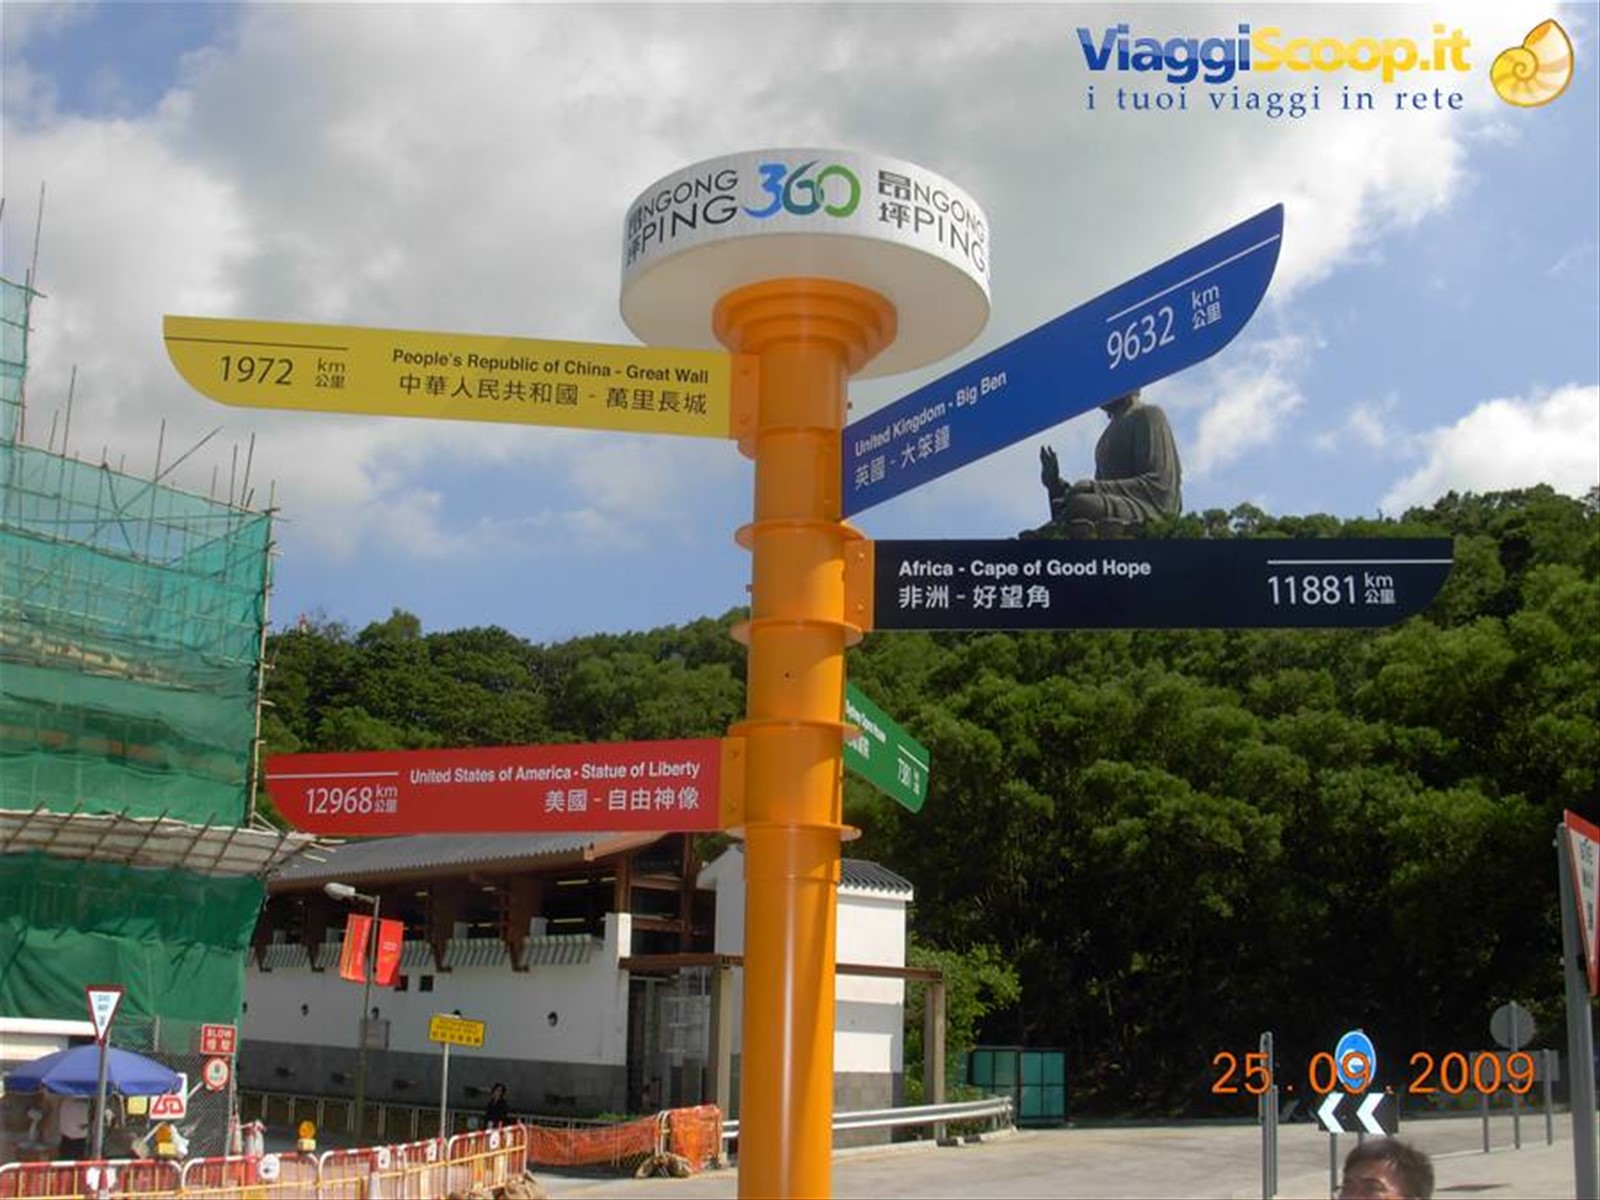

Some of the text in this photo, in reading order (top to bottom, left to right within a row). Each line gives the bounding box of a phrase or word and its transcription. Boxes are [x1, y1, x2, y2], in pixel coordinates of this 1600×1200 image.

[643, 169, 738, 220] NGONG
[741, 160, 861, 219] 360
[641, 195, 738, 254] PING
[914, 205, 986, 273] PING
[1191, 285, 1220, 310] km
[1191, 301, 1222, 330] 公里
[1107, 306, 1176, 370] 9632
[220, 355, 294, 386] 1972
[317, 358, 346, 373] km
[393, 349, 463, 367] People's
[467, 353, 538, 374] Republic
[543, 358, 560, 374] of
[564, 359, 611, 377] China
[626, 364, 670, 382] Great
[675, 369, 709, 384] Wall
[315, 374, 346, 389] 公里
[399, 372, 578, 406] 中華人民共和國
[606, 386, 707, 416] 萬里長城
[855, 424, 892, 457] United
[892, 402, 946, 437] Kingdom
[956, 386, 978, 408] Big
[981, 371, 1007, 395] Ben
[899, 560, 954, 577] Africa
[970, 560, 1019, 579] Cape
[1023, 559, 1042, 577] of
[1047, 559, 1097, 576] Good
[1102, 559, 1151, 579] Hope
[1364, 572, 1394, 588] km
[899, 584, 950, 609] 非洲
[973, 584, 1051, 609] 好望角
[1268, 575, 1355, 605] 11881
[410, 768, 451, 784] United
[454, 767, 495, 783] States
[498, 766, 512, 781] of
[515, 764, 571, 781] America
[581, 763, 626, 780] Statue
[630, 762, 645, 778] of
[648, 761, 700, 779] Liberty
[305, 786, 373, 814] 12968
[375, 784, 398, 798] km
[545, 789, 588, 813] 美國
[608, 786, 700, 811] 自由神像
